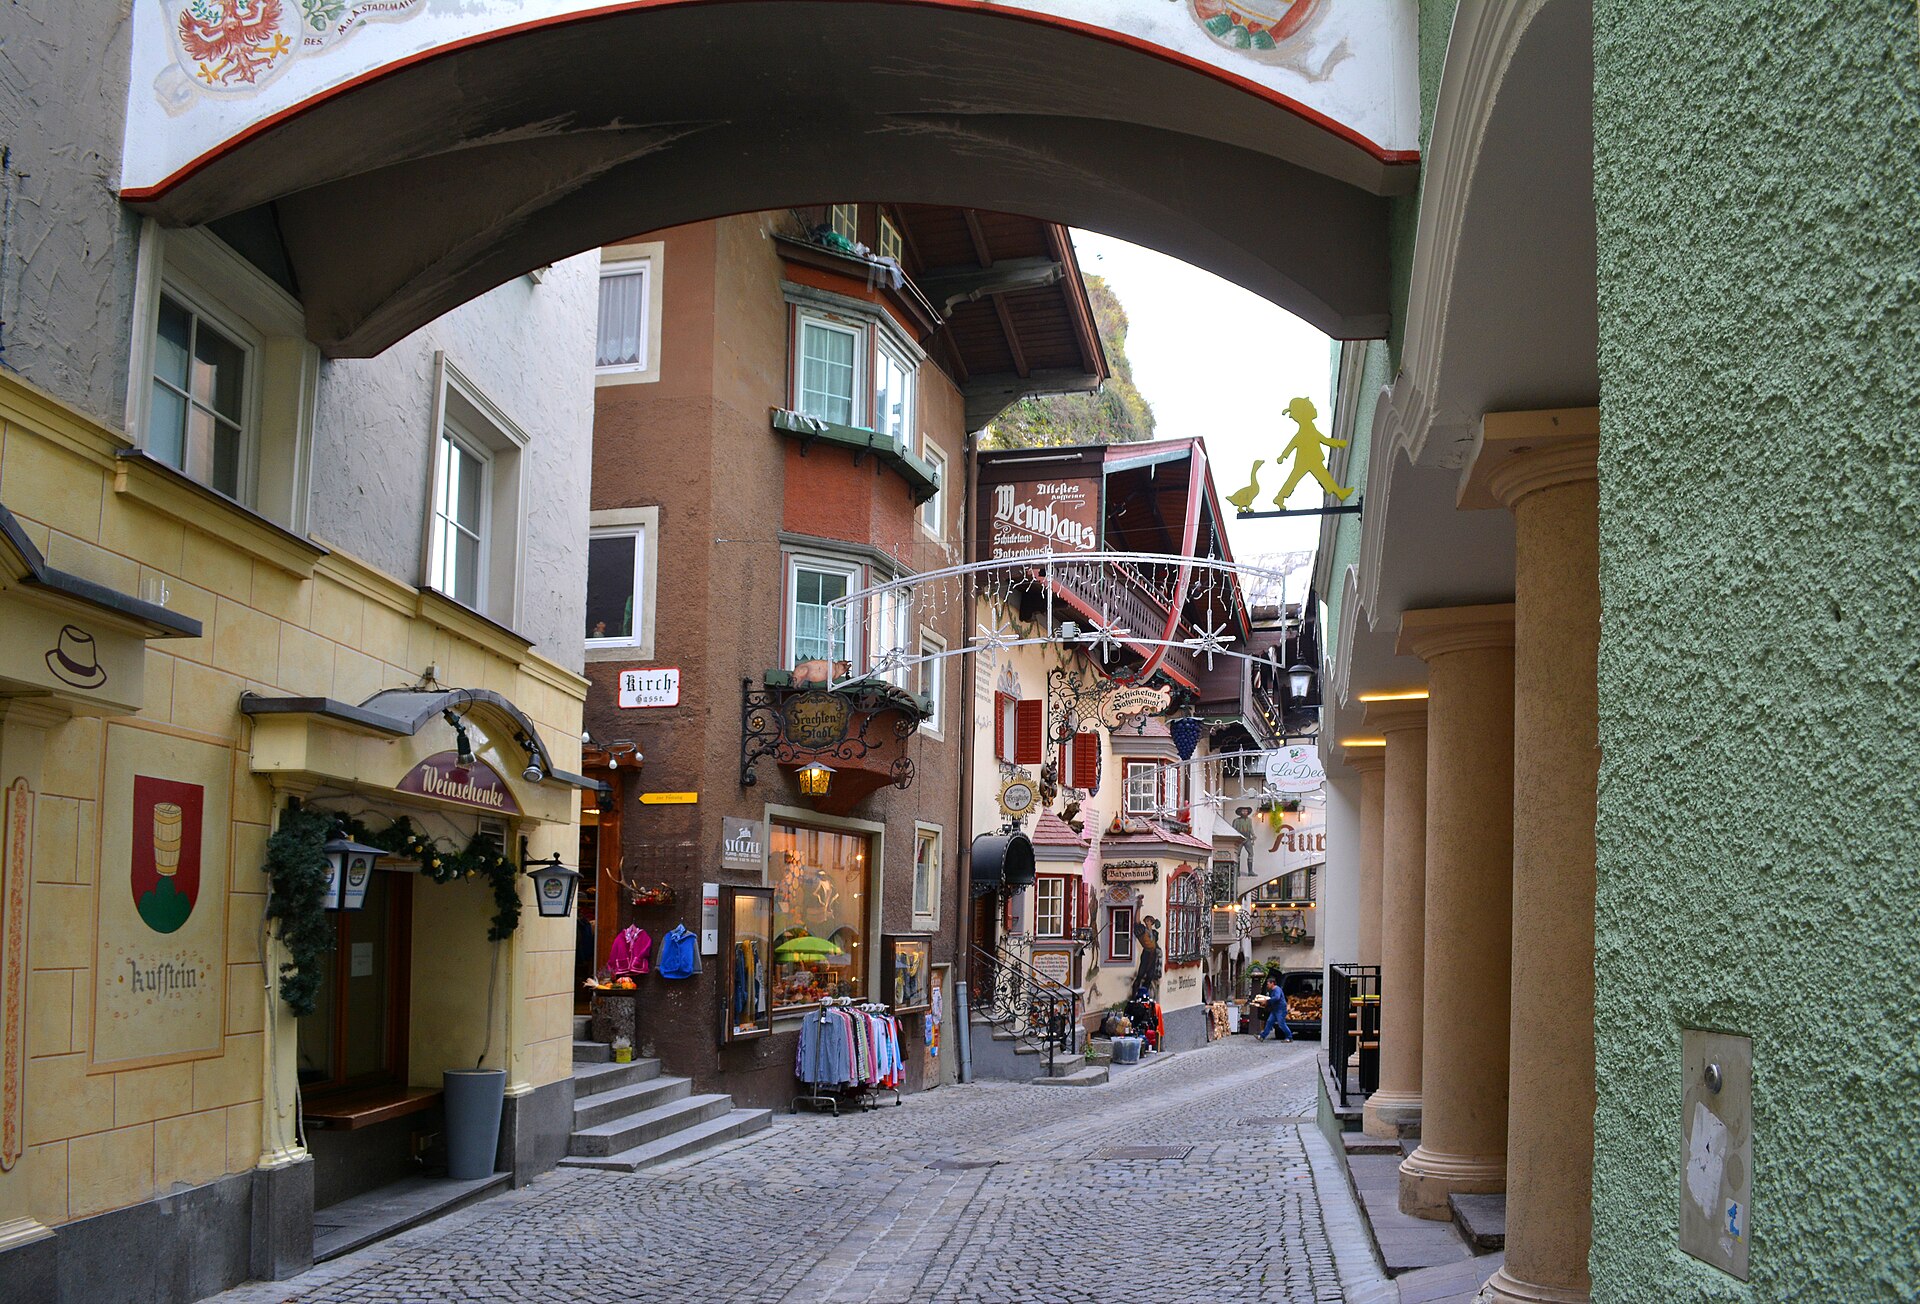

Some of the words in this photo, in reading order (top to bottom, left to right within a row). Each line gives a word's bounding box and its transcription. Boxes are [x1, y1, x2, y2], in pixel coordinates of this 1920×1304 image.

[994, 484, 1096, 551] Weinhaus
[790, 709, 837, 728] Trachten
[801, 725, 833, 739] Stadl
[420, 764, 504, 808] Weinschenke
